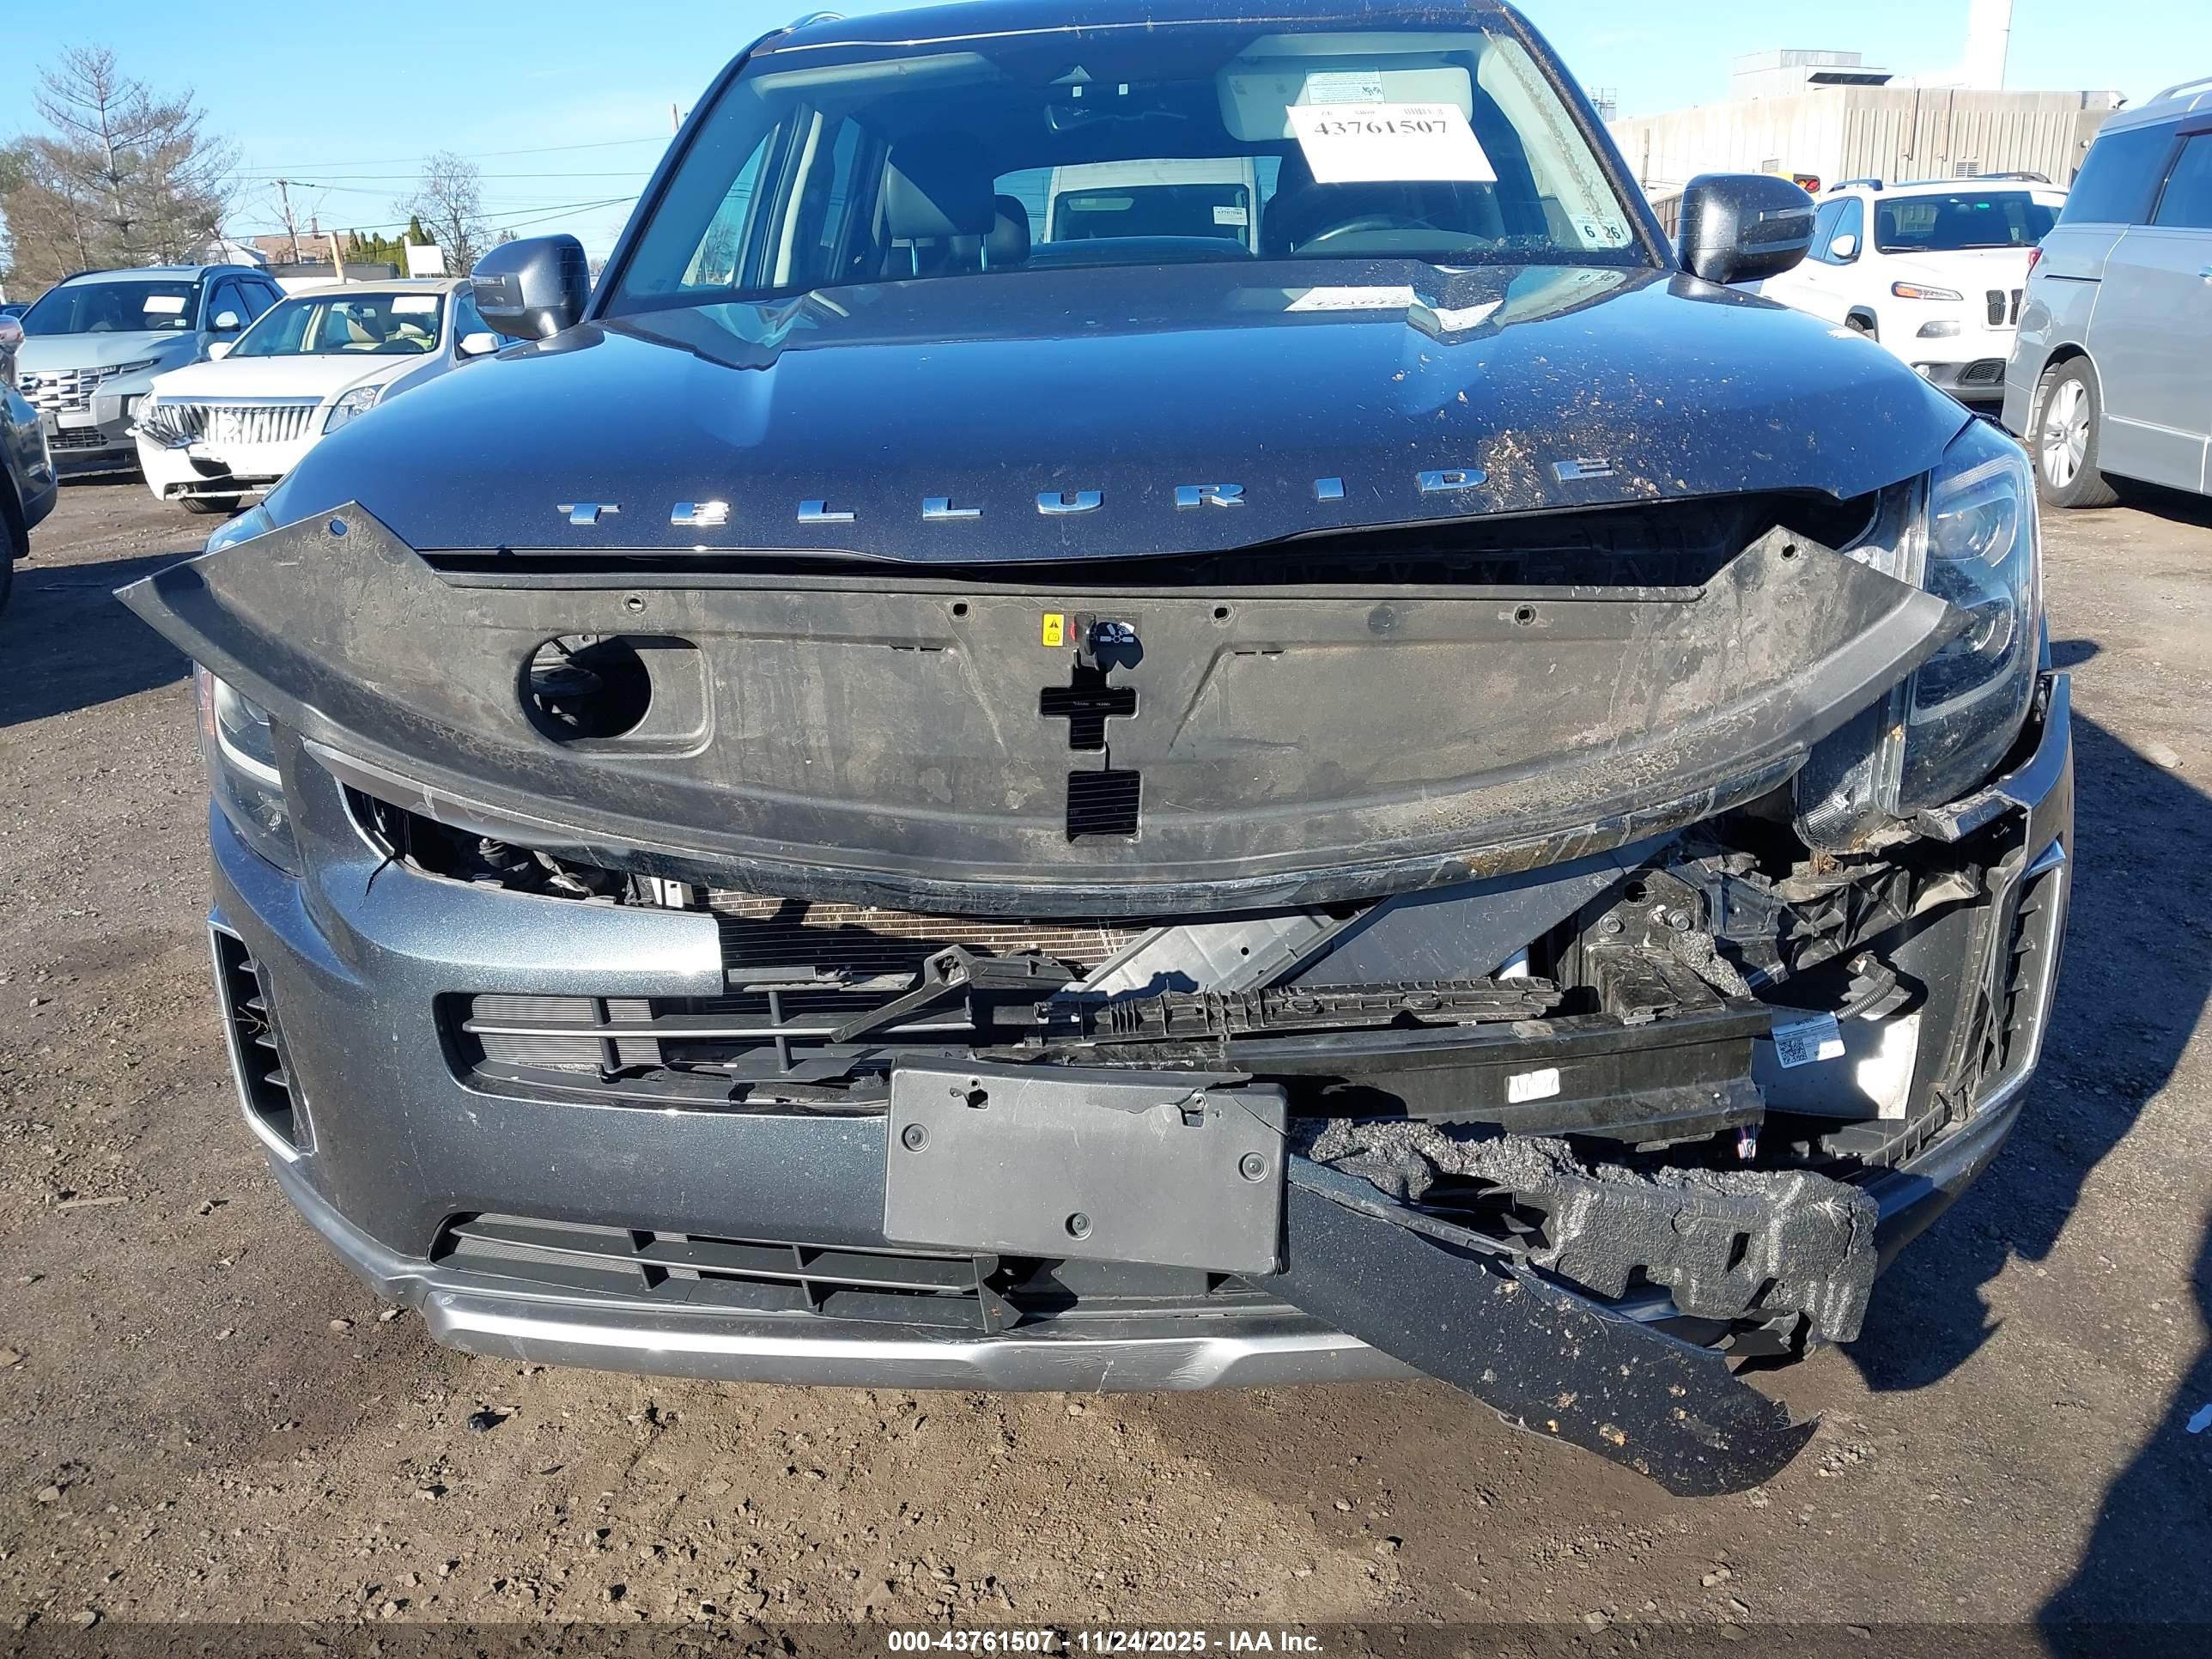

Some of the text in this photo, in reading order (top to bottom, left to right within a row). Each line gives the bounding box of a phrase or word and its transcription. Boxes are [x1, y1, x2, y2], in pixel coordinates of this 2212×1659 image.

[1315, 120, 1447, 136] 43761507
[1584, 225, 1596, 238] 6
[556, 459, 1613, 525] TELLURIDE
